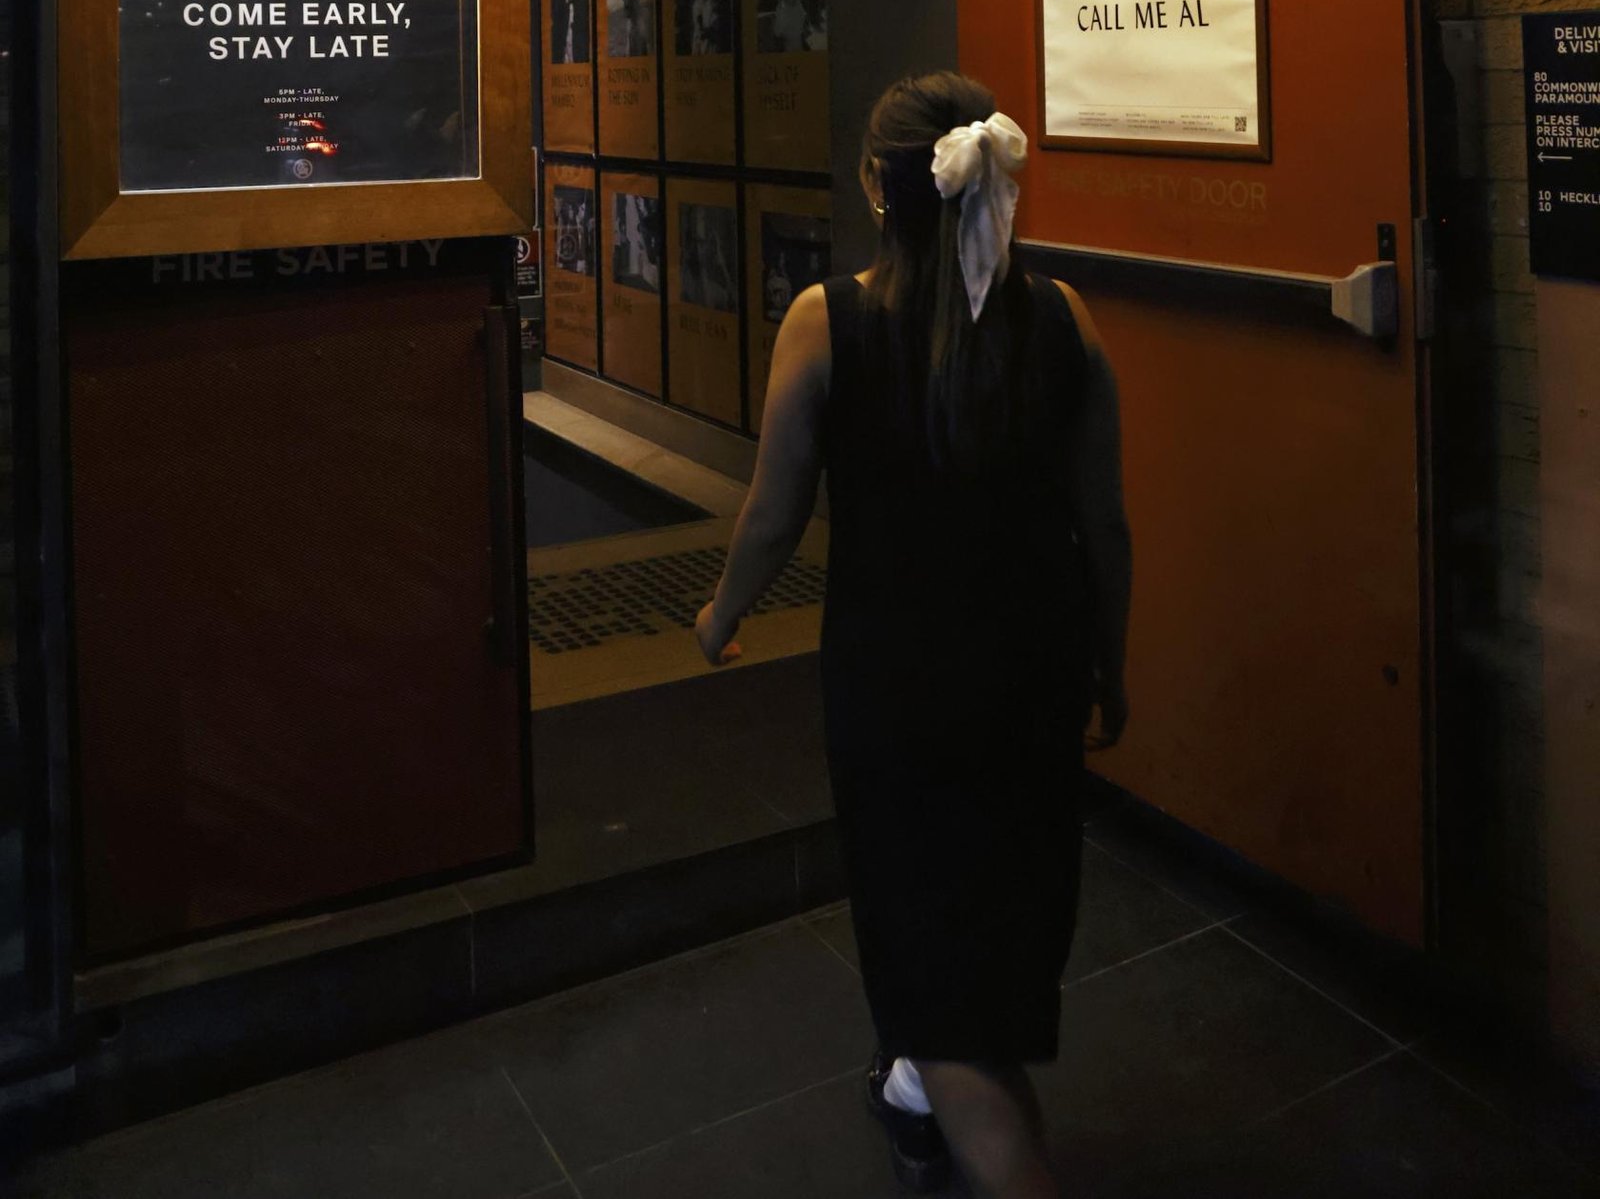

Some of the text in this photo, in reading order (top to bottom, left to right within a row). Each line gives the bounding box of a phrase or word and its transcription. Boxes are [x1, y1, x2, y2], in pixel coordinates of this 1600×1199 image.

[183, 2, 411, 29] COME EARLY,
[1077, 0, 1210, 32] CALL ME AL
[208, 35, 390, 60] STAY LATE
[1557, 40, 1600, 54] & VISI
[1533, 71, 1548, 83] 80
[263, 96, 339, 104] MONDAY-THURSDAY
[1535, 115, 1580, 127] PLEASE
[1536, 126, 1573, 138] PRESS
[1536, 136, 1553, 148] ON
[1190, 176, 1267, 210] DOOR
[1538, 190, 1600, 204] 10 HECKL
[1538, 201, 1552, 212] 10
[152, 238, 445, 284] FIRE SAFETY
